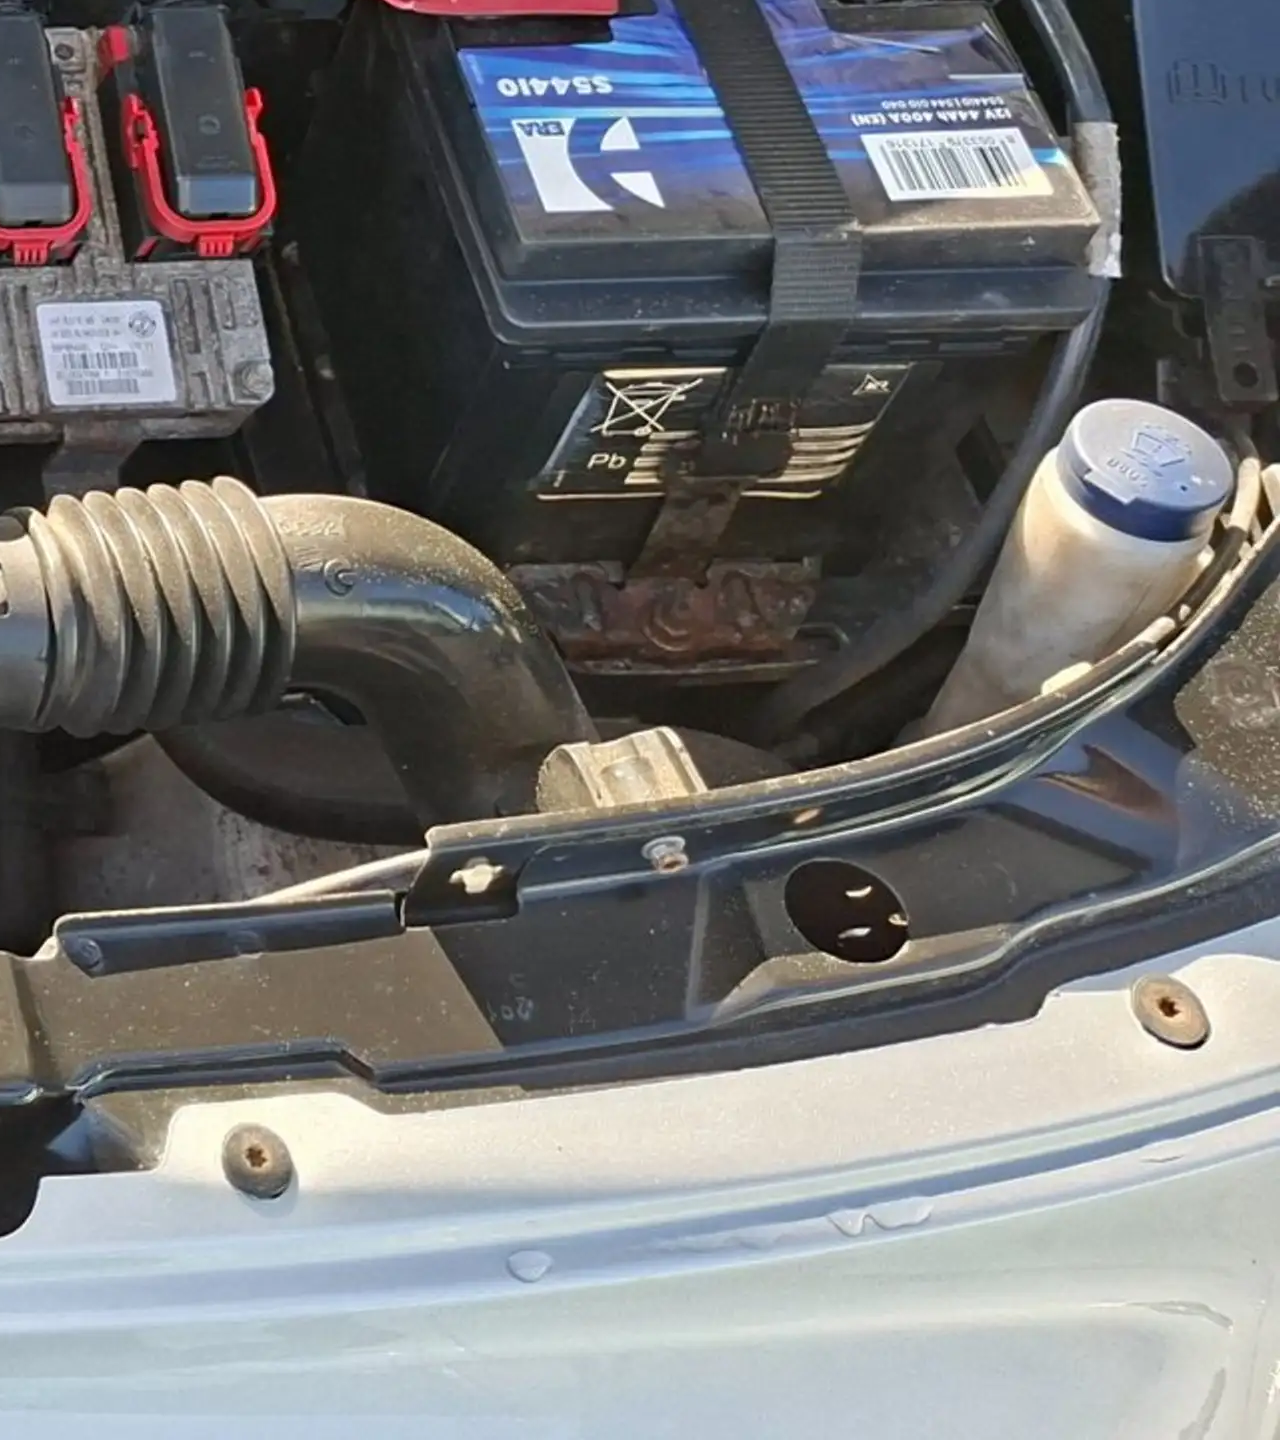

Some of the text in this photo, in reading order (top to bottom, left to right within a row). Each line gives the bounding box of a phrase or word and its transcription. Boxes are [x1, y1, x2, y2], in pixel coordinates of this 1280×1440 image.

[496, 75, 614, 97] S54410
[888, 112, 933, 125] 400A
[984, 107, 1012, 120] 12V
[516, 121, 565, 137] ERA
[588, 453, 627, 470] Pb
